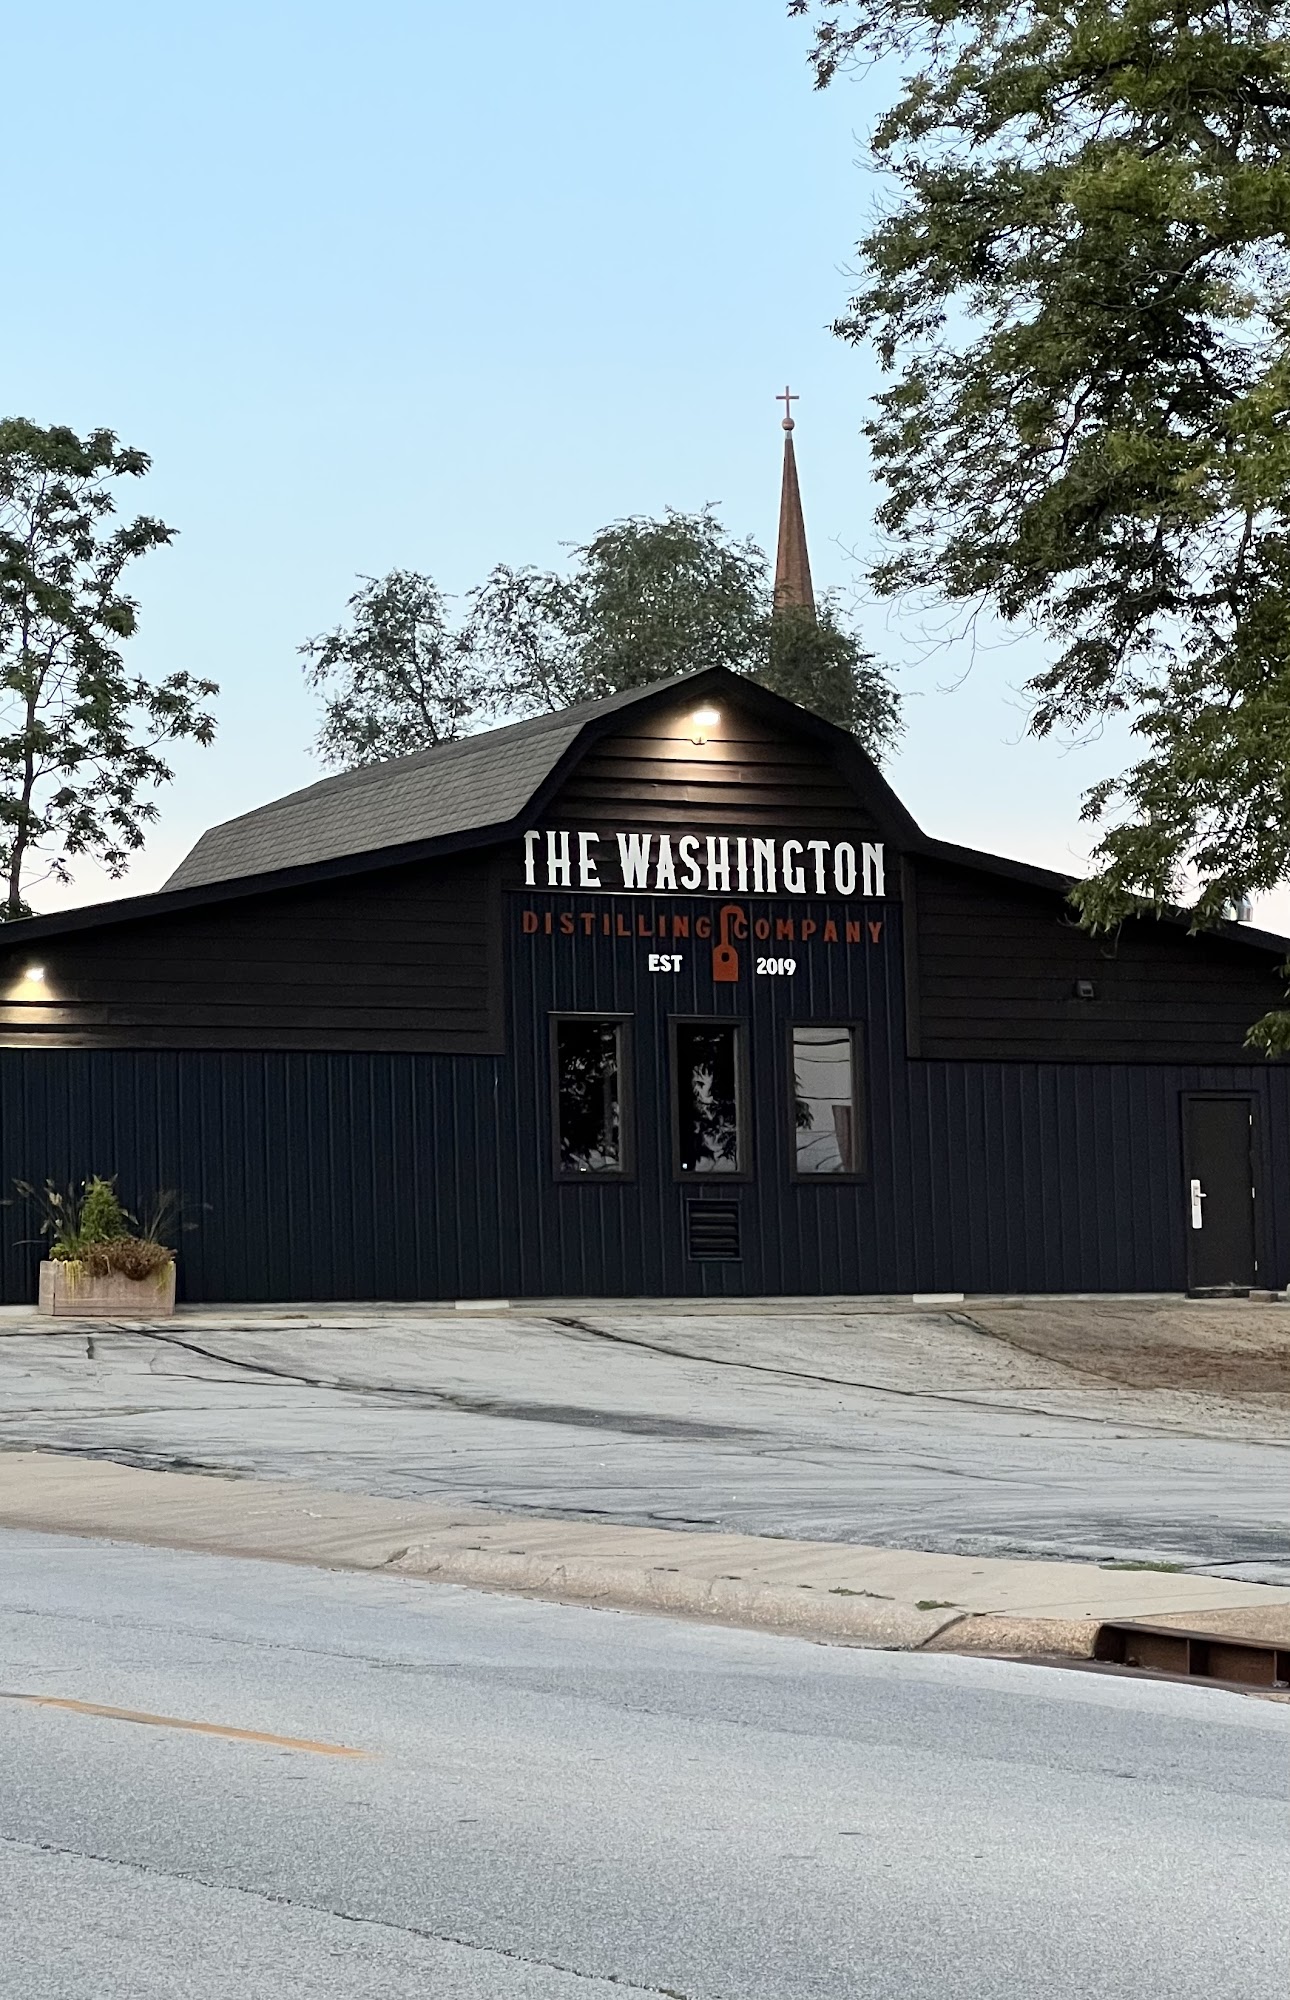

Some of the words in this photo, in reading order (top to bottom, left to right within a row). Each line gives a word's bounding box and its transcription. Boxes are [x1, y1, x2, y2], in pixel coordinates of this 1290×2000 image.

[524, 830, 601, 888] THE
[616, 832, 886, 897] WASHINGTON
[522, 910, 711, 939] DISTILLING
[733, 914, 884, 944] COMPANY
[648, 954, 682, 973] EST
[756, 957, 796, 976] 2019
